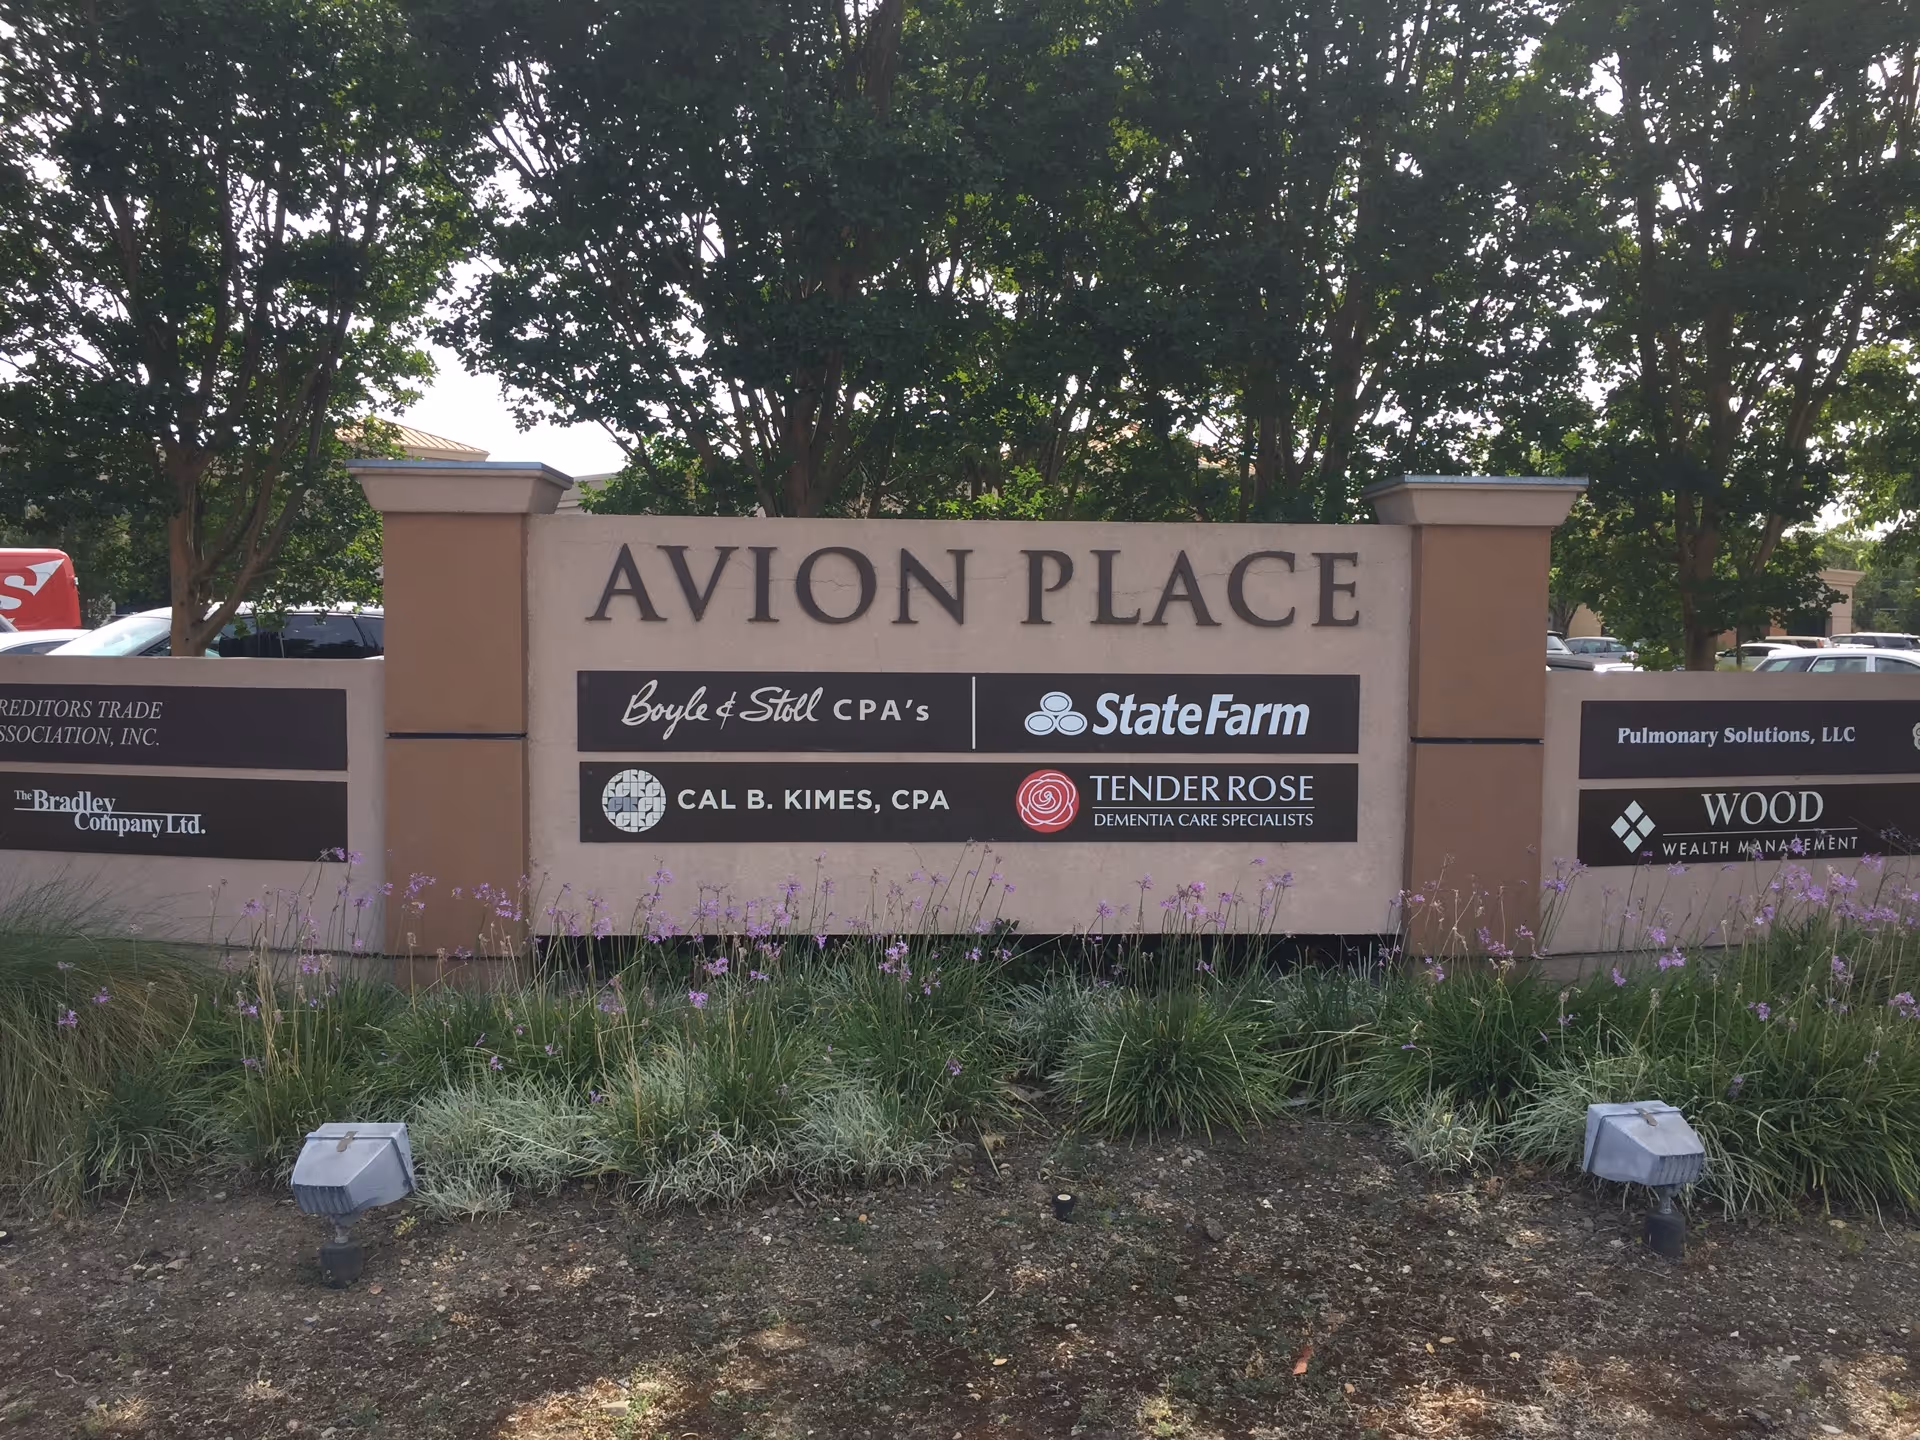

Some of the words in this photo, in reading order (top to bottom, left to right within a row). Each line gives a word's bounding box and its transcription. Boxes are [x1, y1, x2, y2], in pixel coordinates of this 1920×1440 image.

[585, 543, 973, 626] AVION
[1020, 550, 1360, 628] PLACE
[98, 700, 163, 719] TRADE
[621, 679, 710, 740] Boyle
[716, 691, 737, 730] &
[739, 686, 824, 722] Stoll
[833, 699, 930, 721] CPA's
[120, 727, 160, 746] INC.
[1617, 727, 1719, 747] Pulmonary
[1723, 726, 1816, 745] Solutions,
[1821, 726, 1856, 742] LLC
[678, 789, 737, 810] CAL
[747, 789, 773, 810] B.
[784, 789, 881, 813] KIMES,
[891, 789, 950, 810] CPA
[1089, 775, 1220, 802] TENDER
[1228, 775, 1314, 802] ROSE
[14, 790, 32, 800] The
[32, 789, 116, 816] Bradley
[1701, 791, 1824, 826] WOOD
[74, 811, 164, 838] Company
[165, 815, 206, 834] Ltd.
[1094, 813, 1174, 826] DEMENTIA
[1178, 813, 1218, 827] CARE
[1221, 813, 1314, 827] SPECIALISTS
[1662, 841, 1729, 856] WEALTH
[1737, 836, 1858, 854] MANAEMENT
